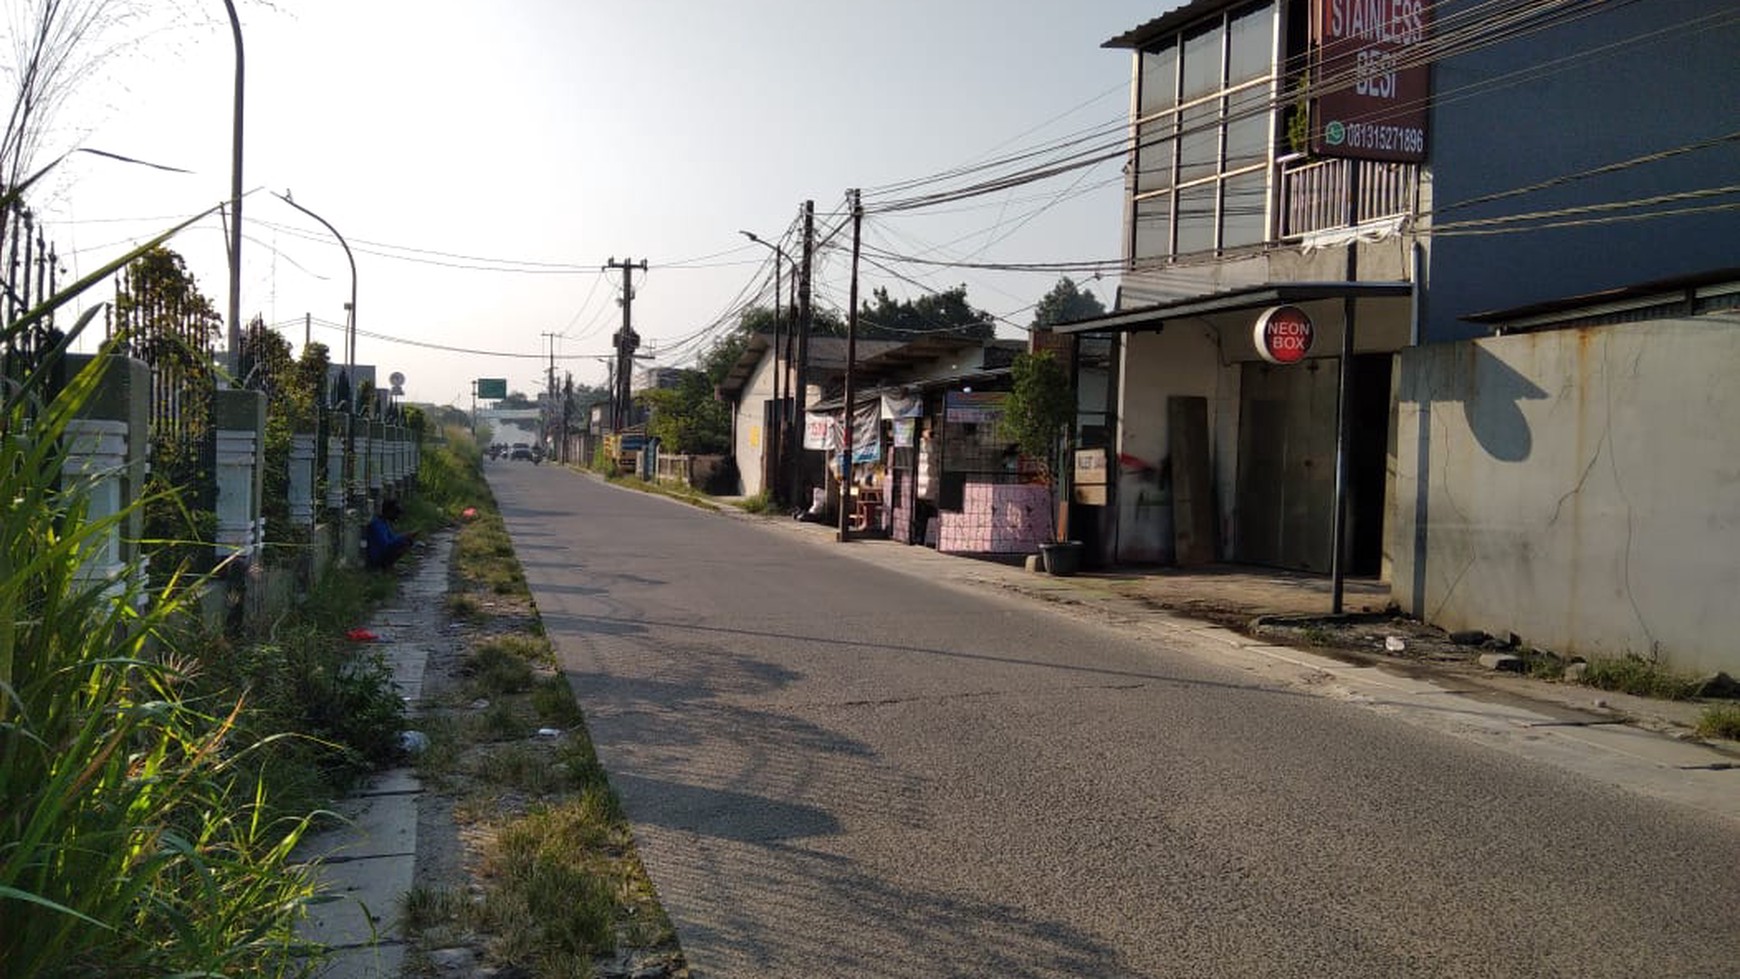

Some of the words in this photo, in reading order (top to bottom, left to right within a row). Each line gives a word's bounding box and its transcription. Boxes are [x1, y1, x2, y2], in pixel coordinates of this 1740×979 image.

[1356, 50, 1396, 99] BESI
[1347, 123, 1424, 152] 081315271896
[1267, 322, 1311, 336] NEON
[1273, 336, 1305, 350] BOX
